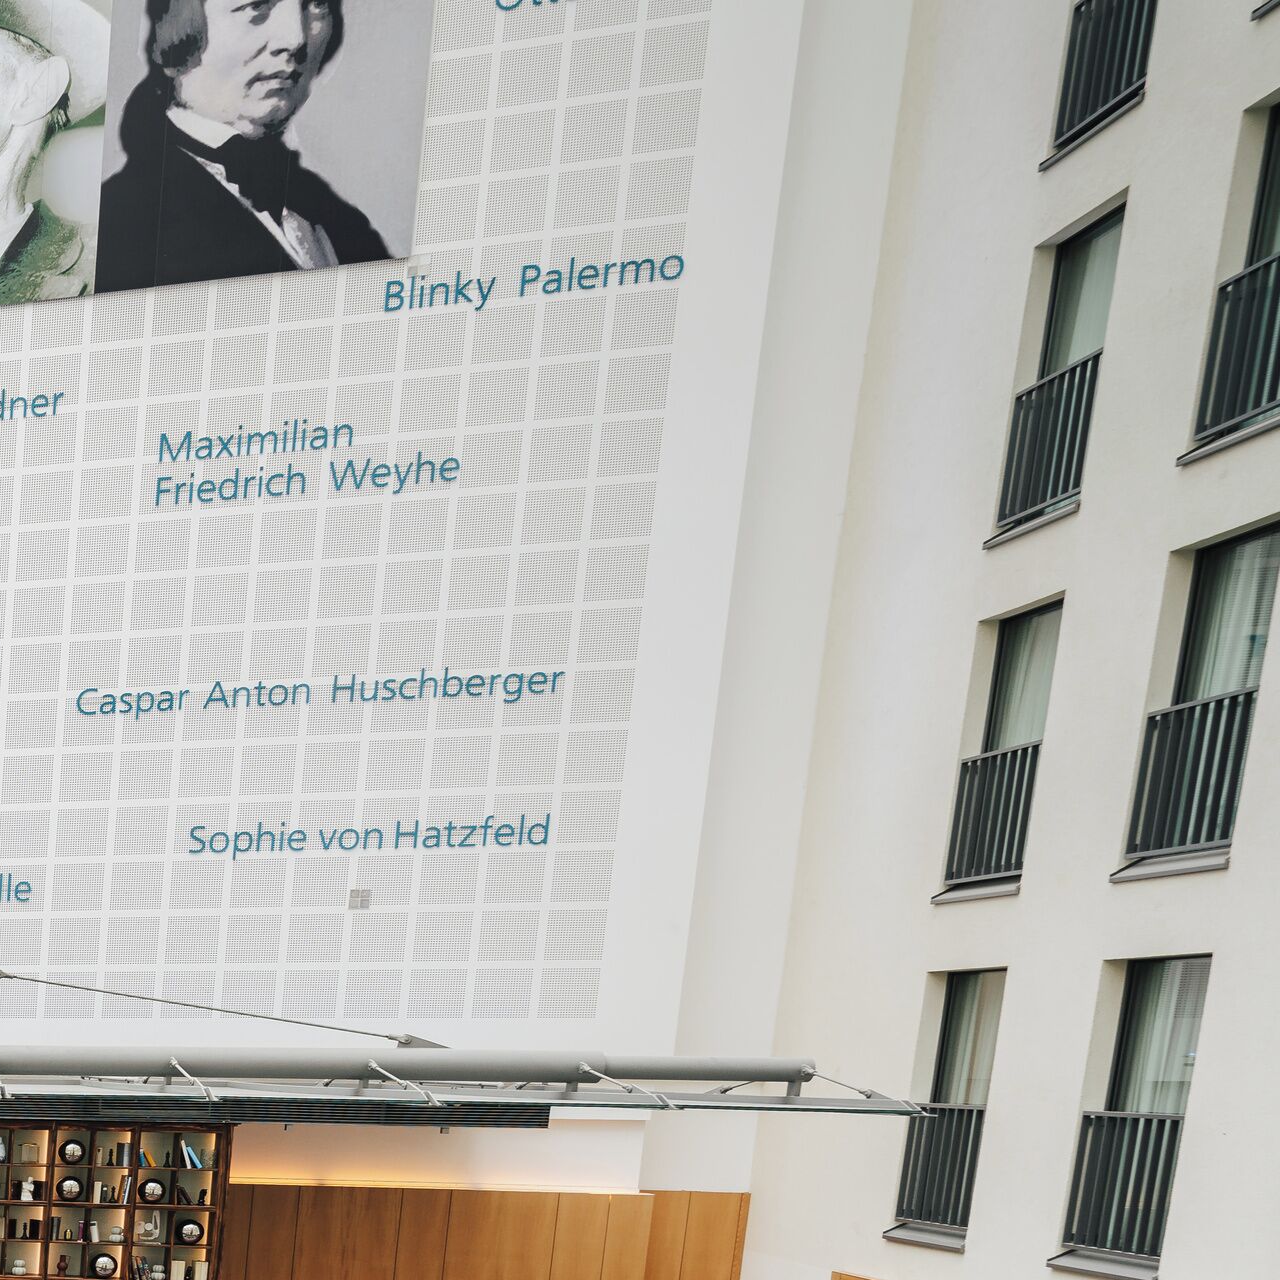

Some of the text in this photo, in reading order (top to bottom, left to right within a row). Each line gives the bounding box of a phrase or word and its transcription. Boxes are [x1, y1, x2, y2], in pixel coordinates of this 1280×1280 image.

[382, 254, 686, 313] Blinky Palermo
[157, 417, 354, 463] Maximilian
[154, 450, 461, 507] Friedrich Weyhe
[75, 666, 566, 722] Caspar Anton Huschberger
[188, 812, 552, 860] Sophie von Hatzfeld
